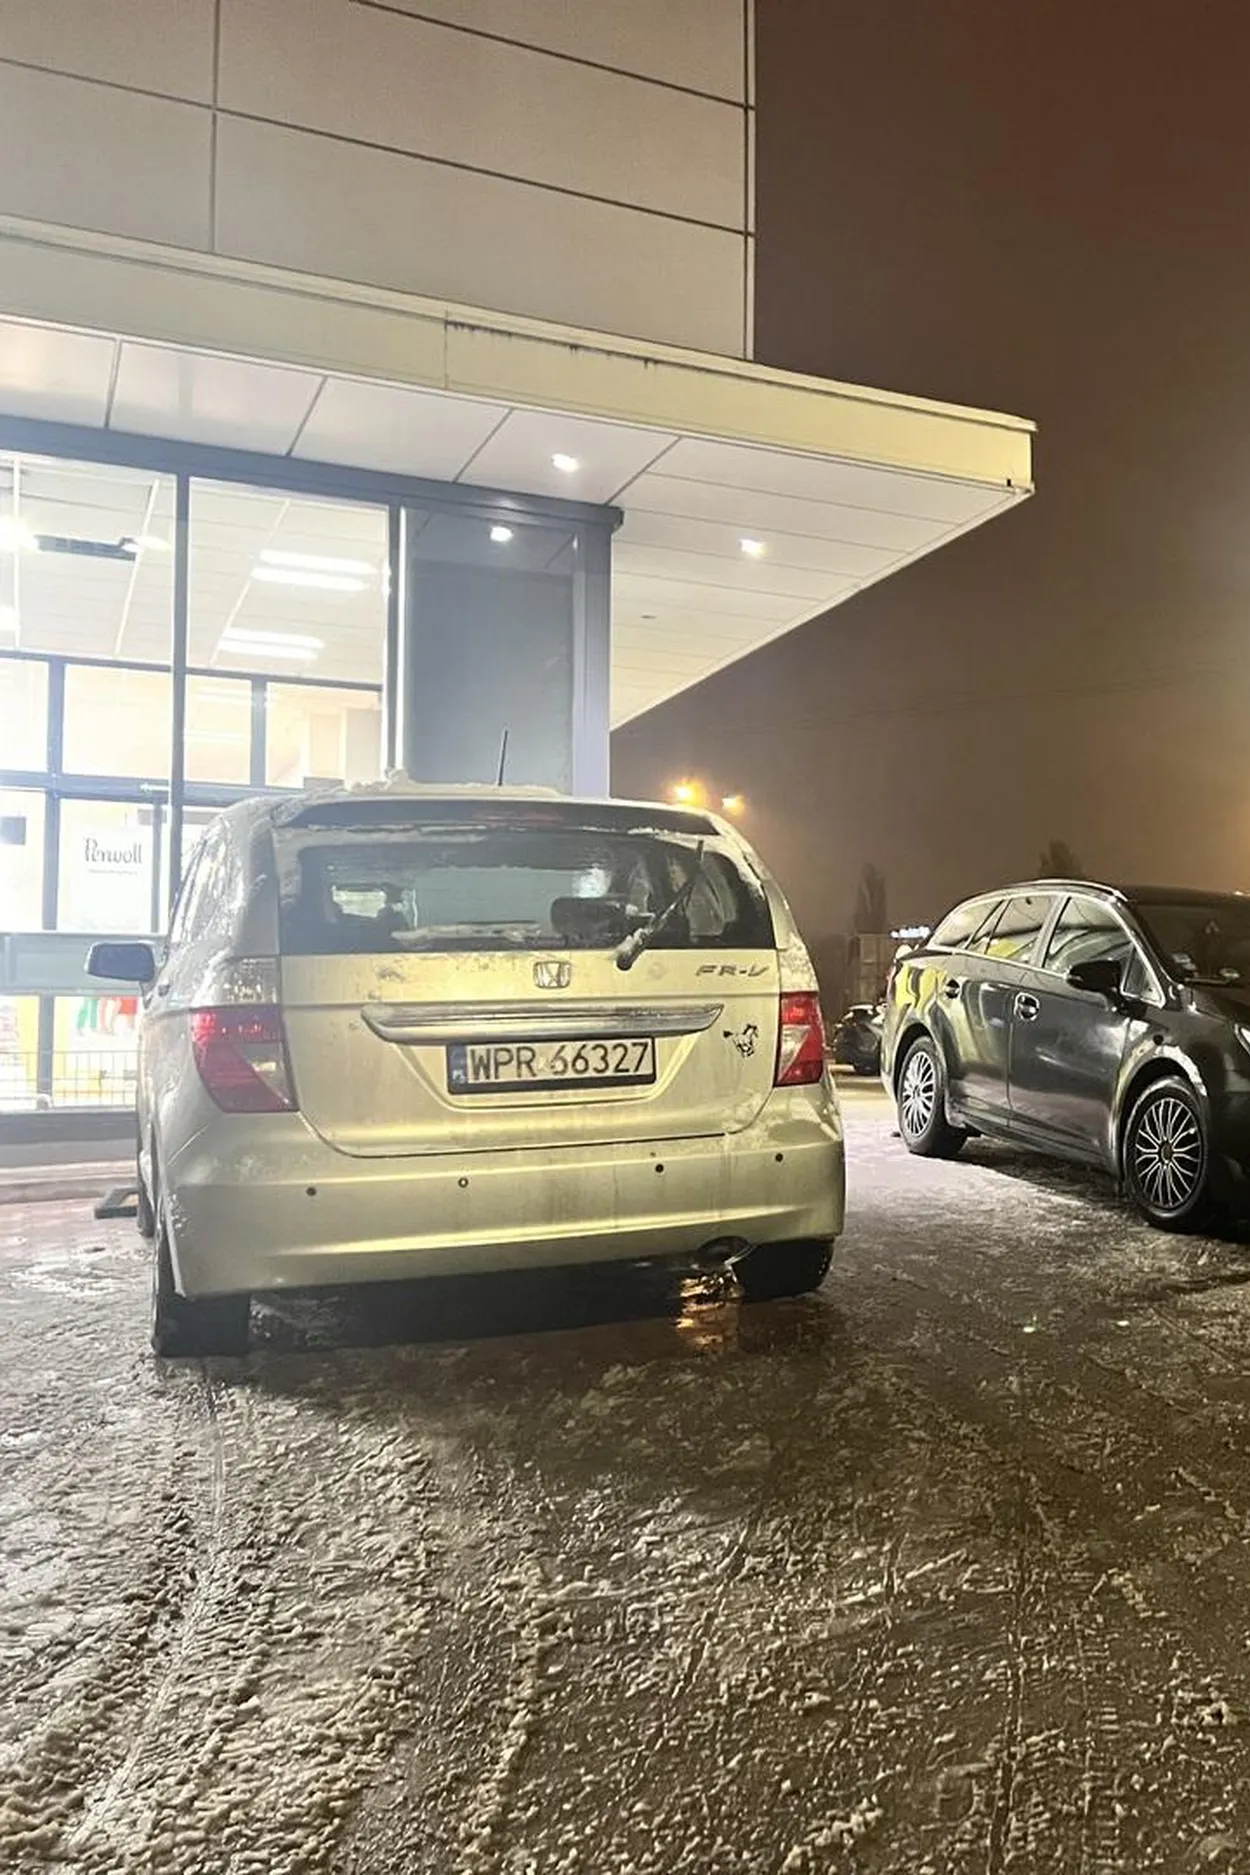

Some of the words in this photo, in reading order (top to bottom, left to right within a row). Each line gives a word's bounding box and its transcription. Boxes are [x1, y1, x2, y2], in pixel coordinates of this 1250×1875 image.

[84, 837, 142, 864] Perwoll
[695, 963, 769, 977] FR-V
[470, 1047, 537, 1081] WPR
[550, 1042, 649, 1076] 66327
